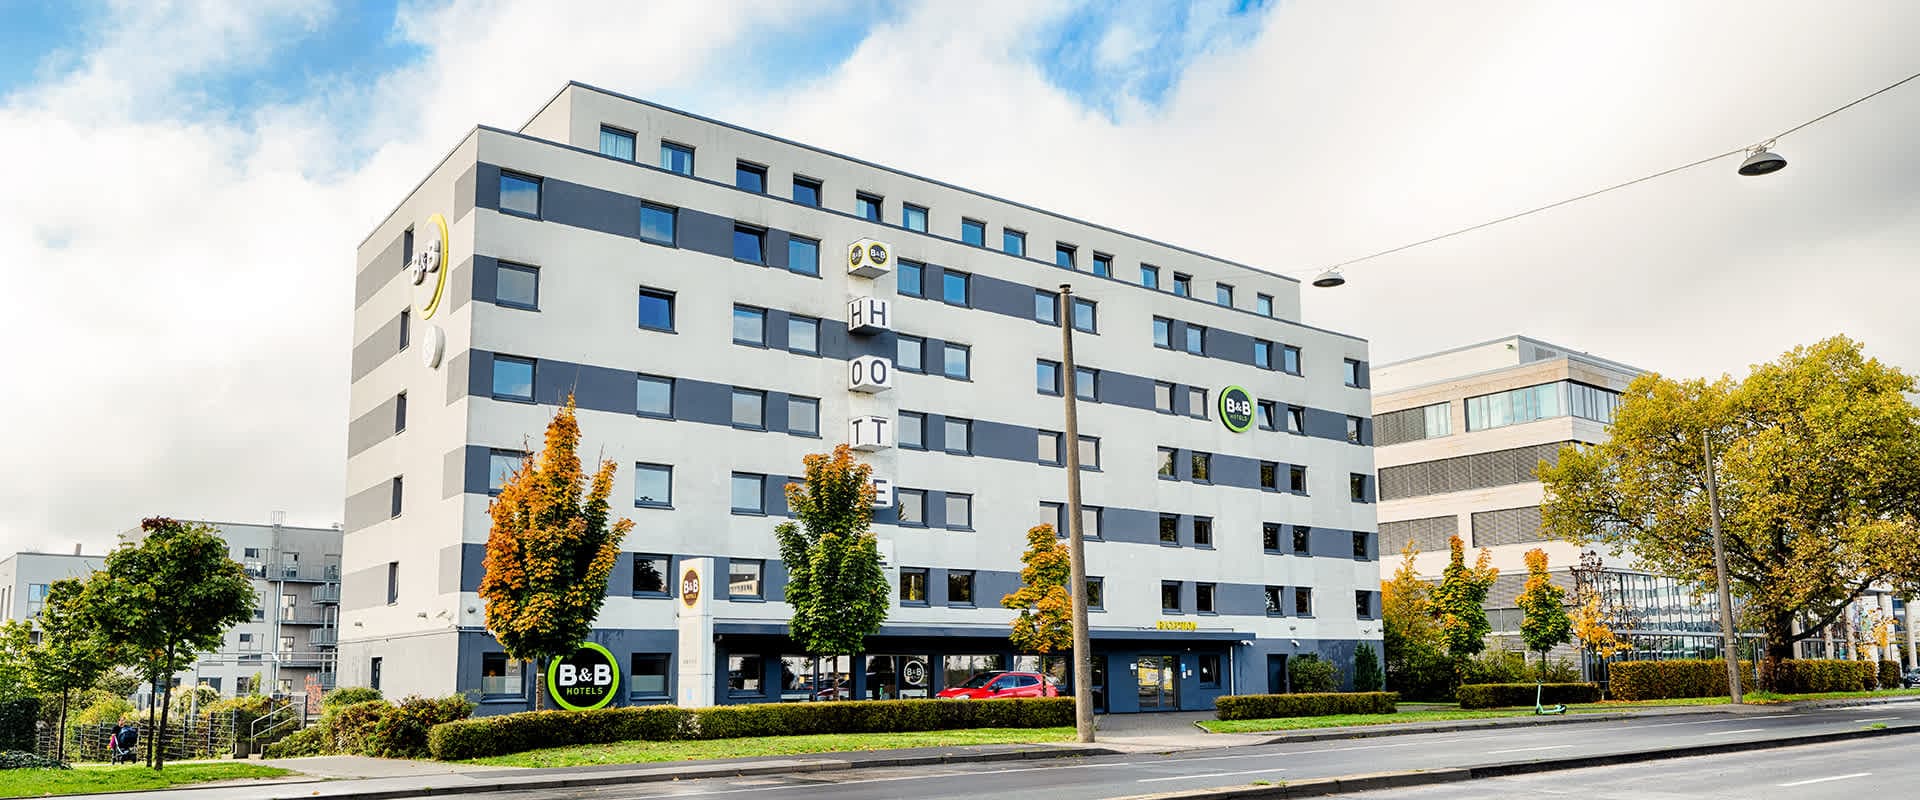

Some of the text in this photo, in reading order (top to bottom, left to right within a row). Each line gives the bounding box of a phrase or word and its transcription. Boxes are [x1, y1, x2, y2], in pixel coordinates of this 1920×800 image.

[870, 249, 886, 259] B&B
[1226, 398, 1251, 416] B&B
[683, 579, 699, 594] B&B
[559, 664, 612, 686] B&B
[906, 667, 922, 676] B&B
[566, 687, 603, 696] HOTELS
